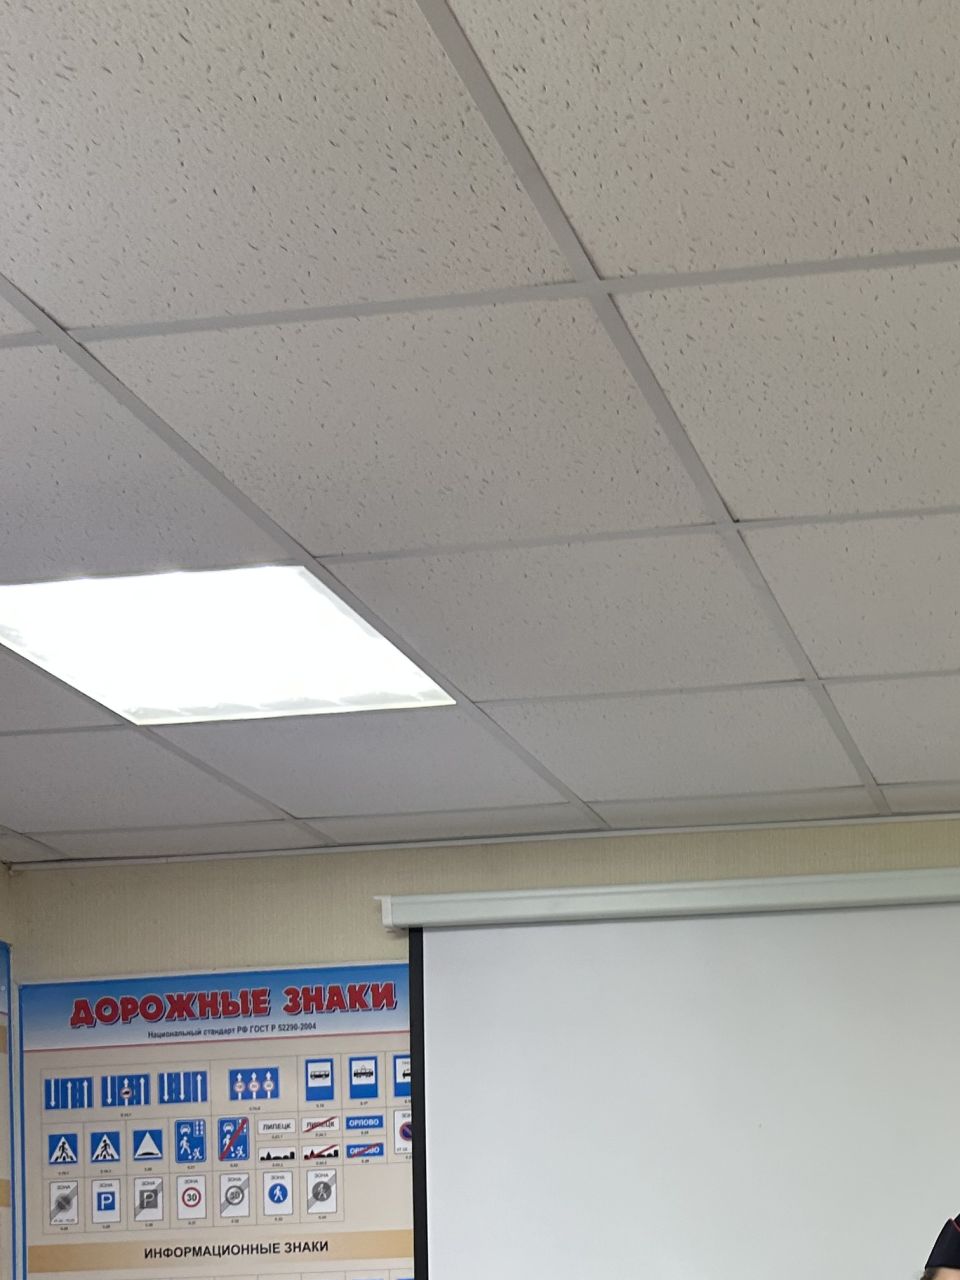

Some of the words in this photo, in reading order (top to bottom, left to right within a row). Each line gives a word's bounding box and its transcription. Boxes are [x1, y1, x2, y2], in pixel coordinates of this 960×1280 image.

[70, 985, 272, 1029] ДОРОЖНЫЕ
[283, 981, 398, 1016] ЗНАКИ
[148, 1029, 201, 1039] Национальный
[203, 1028, 235, 1037] стандарт
[237, 1026, 248, 1034] РФ
[250, 1025, 269, 1033] ГОСТ
[186, 1193, 197, 1202] 30
[144, 1243, 280, 1259] ИНФОРМАЦИОННЫЕ
[284, 1241, 329, 1253] ЗНАКИ
